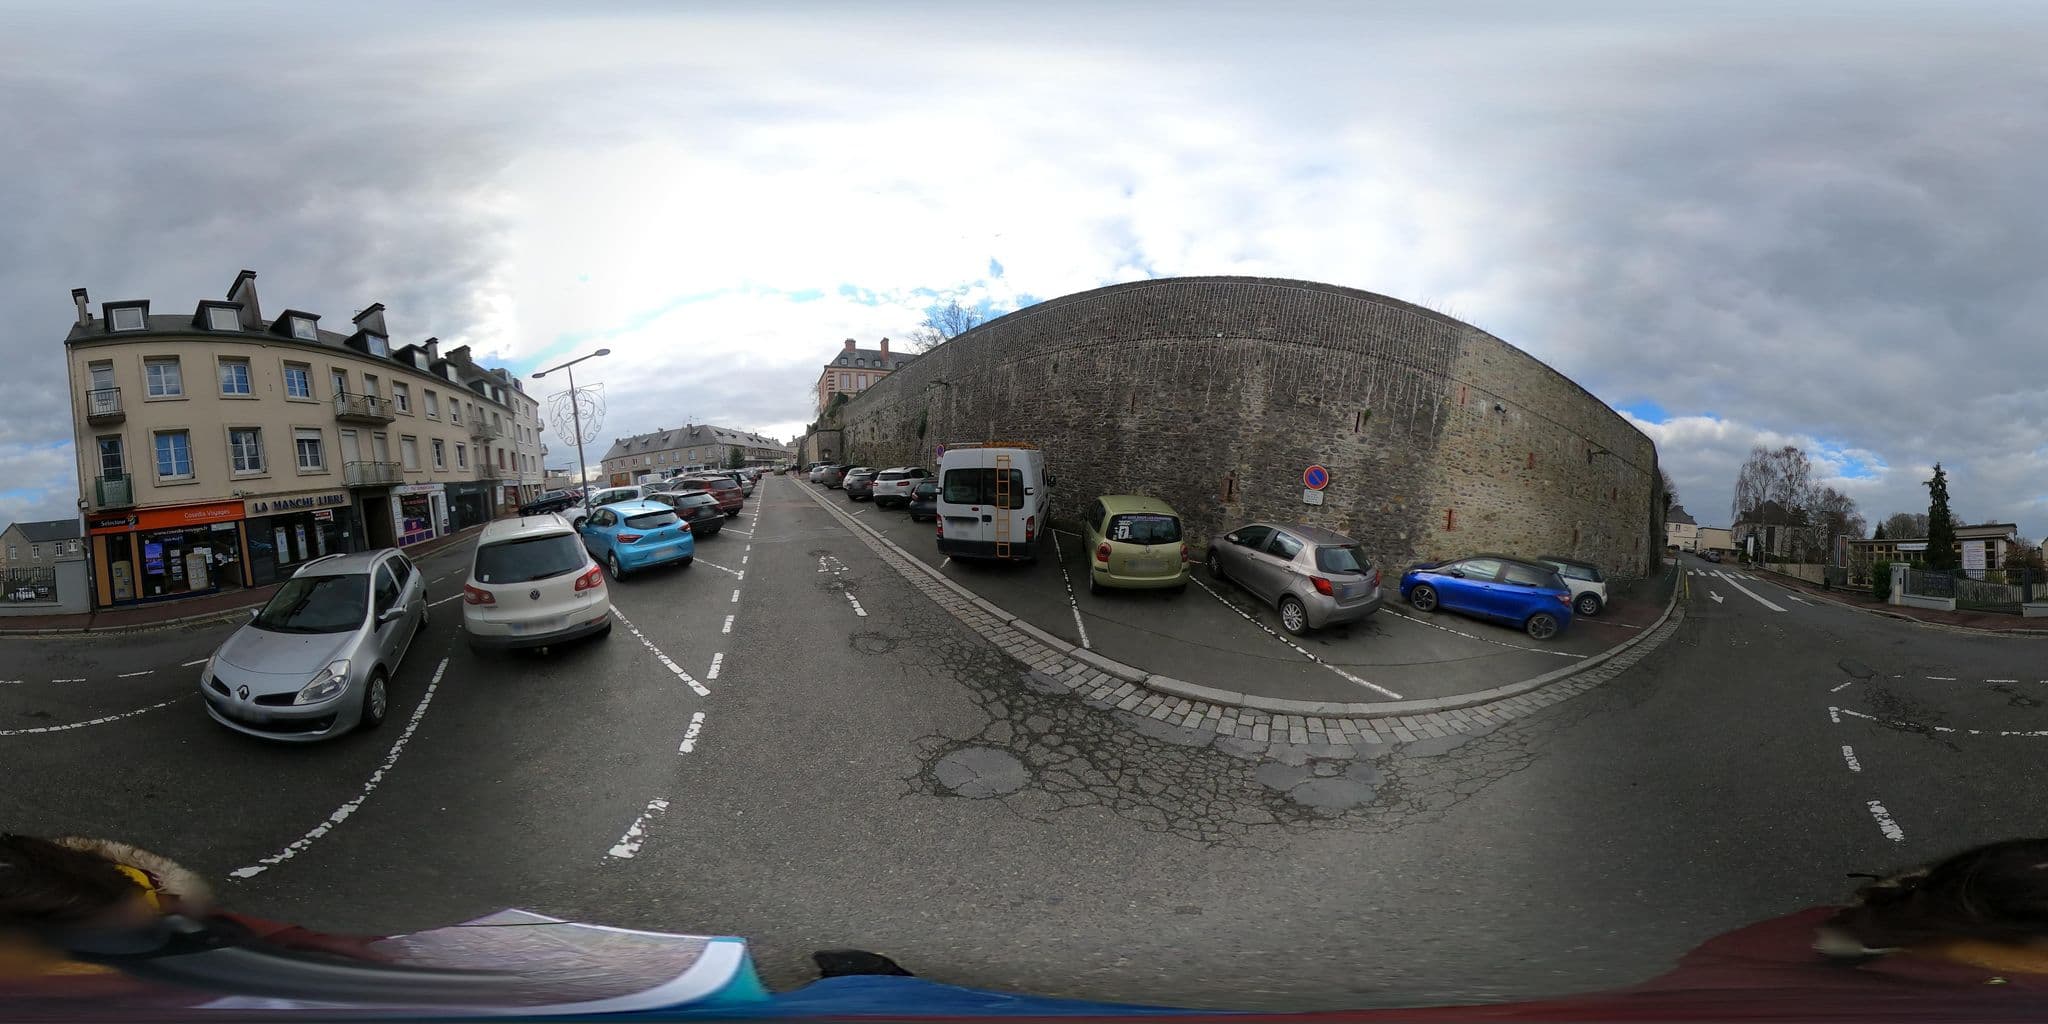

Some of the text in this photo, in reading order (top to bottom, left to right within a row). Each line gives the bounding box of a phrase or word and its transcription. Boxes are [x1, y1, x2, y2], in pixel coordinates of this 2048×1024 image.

[254, 494, 344, 513] LA MANCHE LIBRE
[207, 509, 230, 518] Voyages
